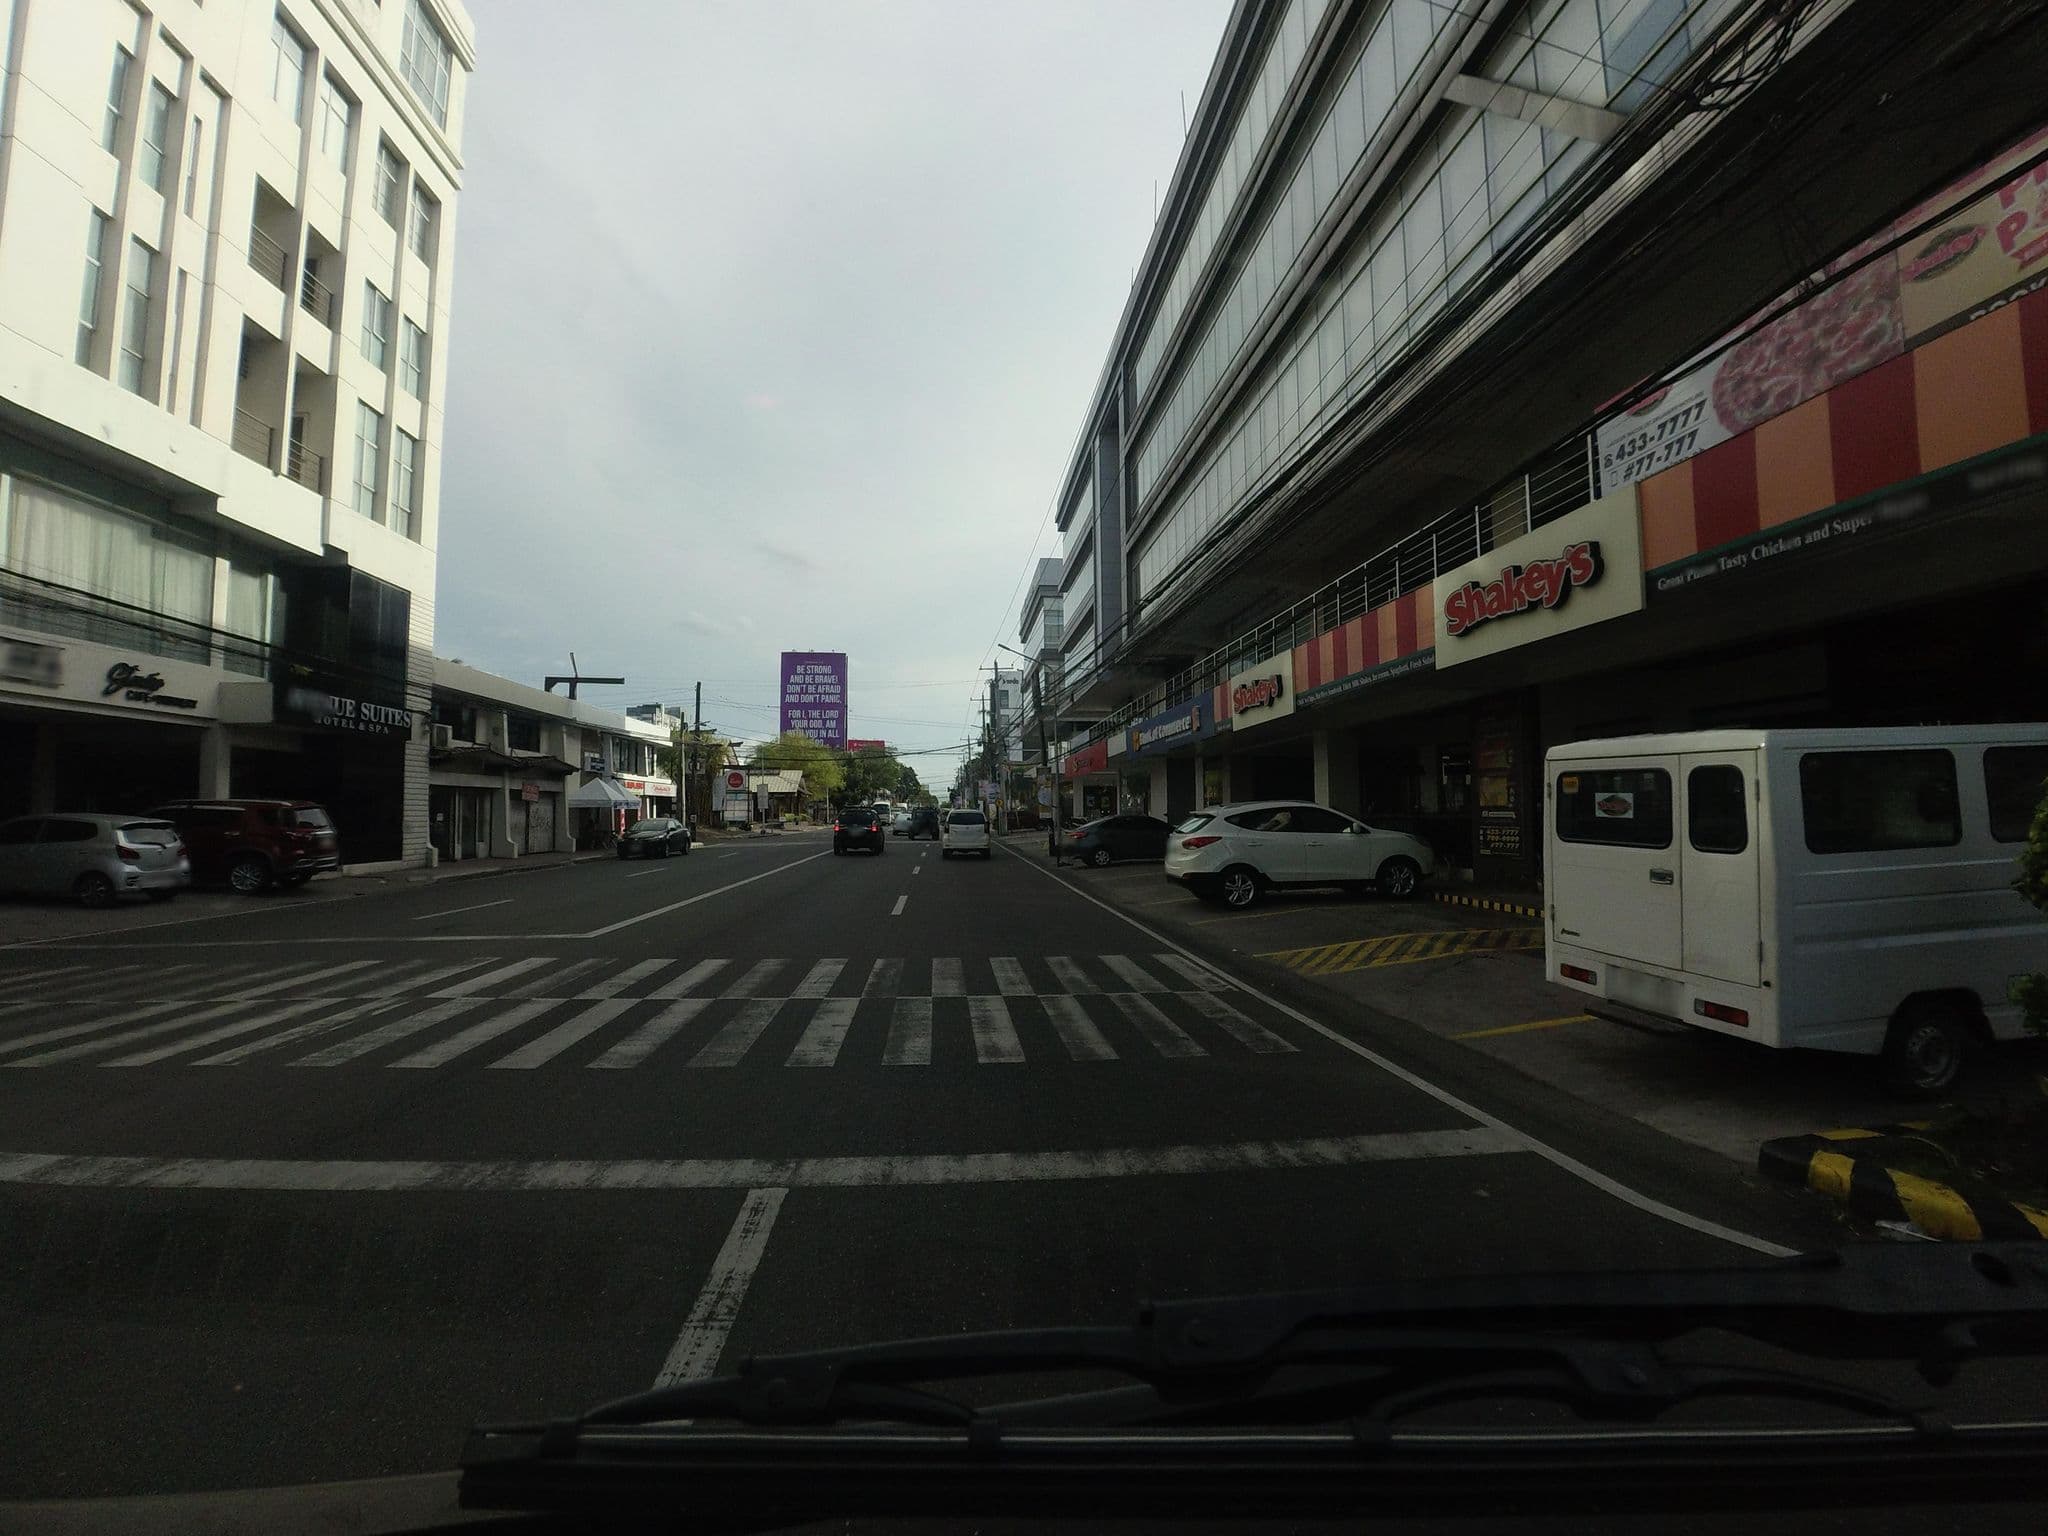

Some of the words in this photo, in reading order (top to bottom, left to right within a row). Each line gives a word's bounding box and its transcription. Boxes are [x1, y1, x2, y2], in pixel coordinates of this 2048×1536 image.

[1616, 399, 1707, 460] 433-7777
[1624, 428, 1699, 481] #77-777
[1719, 553, 1747, 571] Tasty
[1804, 522, 1830, 544] and
[1445, 542, 1602, 636] Shakey's
[797, 665, 806, 674] BE
[806, 665, 832, 674] STRONG
[790, 675, 804, 684] AND
[805, 675, 815, 684] BE
[815, 675, 838, 684] BRAVE!
[787, 685, 806, 694] DON'T
[808, 685, 816, 694] BE
[817, 685, 841, 694] AFRAID
[1233, 675, 1281, 714] Shakey's
[785, 695, 799, 703] AND
[801, 695, 820, 703] DON'T
[361, 702, 412, 729] SUITES
[788, 710, 801, 719] FOR
[808, 710, 821, 719] THE
[822, 710, 839, 719] LORD
[368, 723, 389, 735] SPA
[791, 720, 808, 728] YOUR
[826, 720, 837, 728] AM
[806, 730, 818, 738] YOU
[819, 730, 827, 738] IN
[828, 730, 840, 738] ALL
